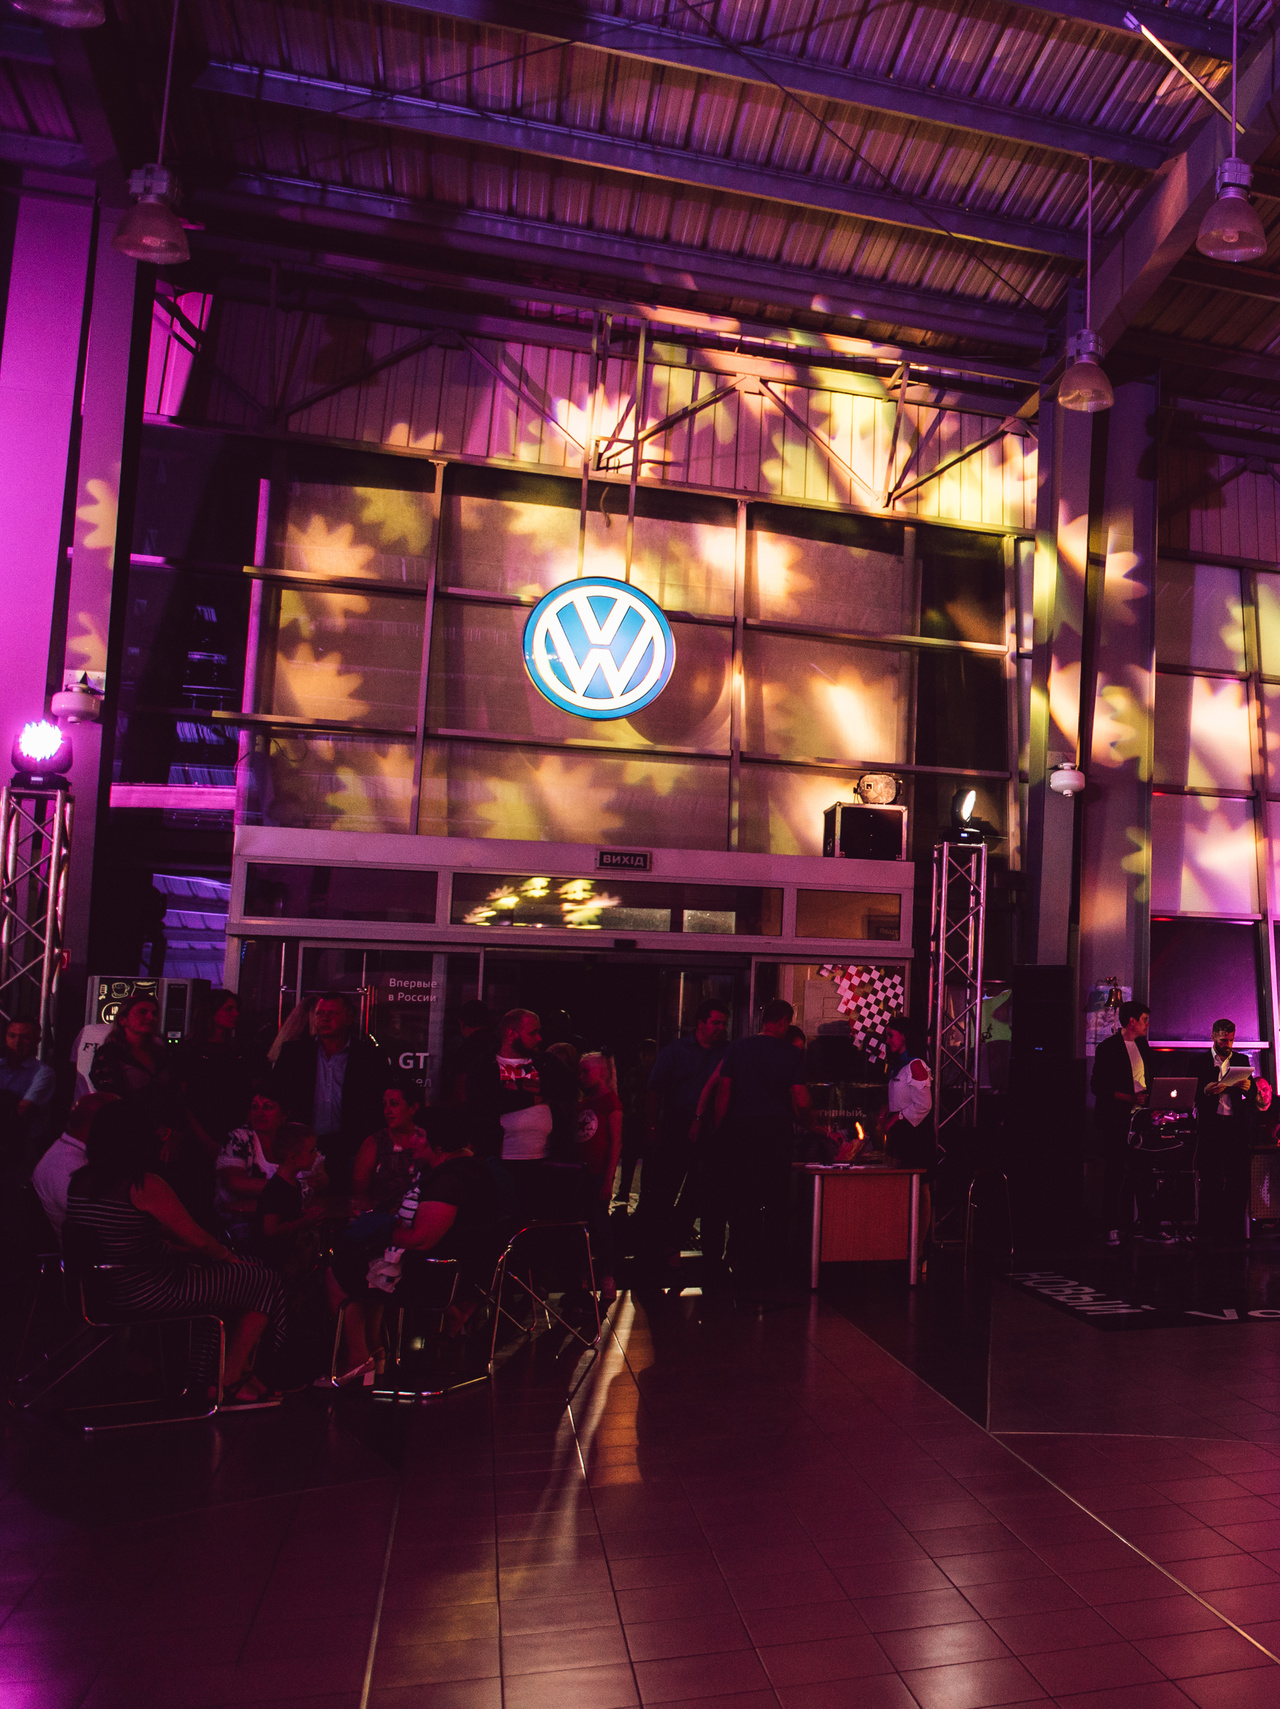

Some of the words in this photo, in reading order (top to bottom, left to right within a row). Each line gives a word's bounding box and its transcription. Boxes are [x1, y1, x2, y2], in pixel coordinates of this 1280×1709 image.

[602, 854, 645, 867] ВИХІД
[388, 978, 437, 989] Впервые
[388, 993, 394, 1001] в
[397, 992, 437, 1002] России
